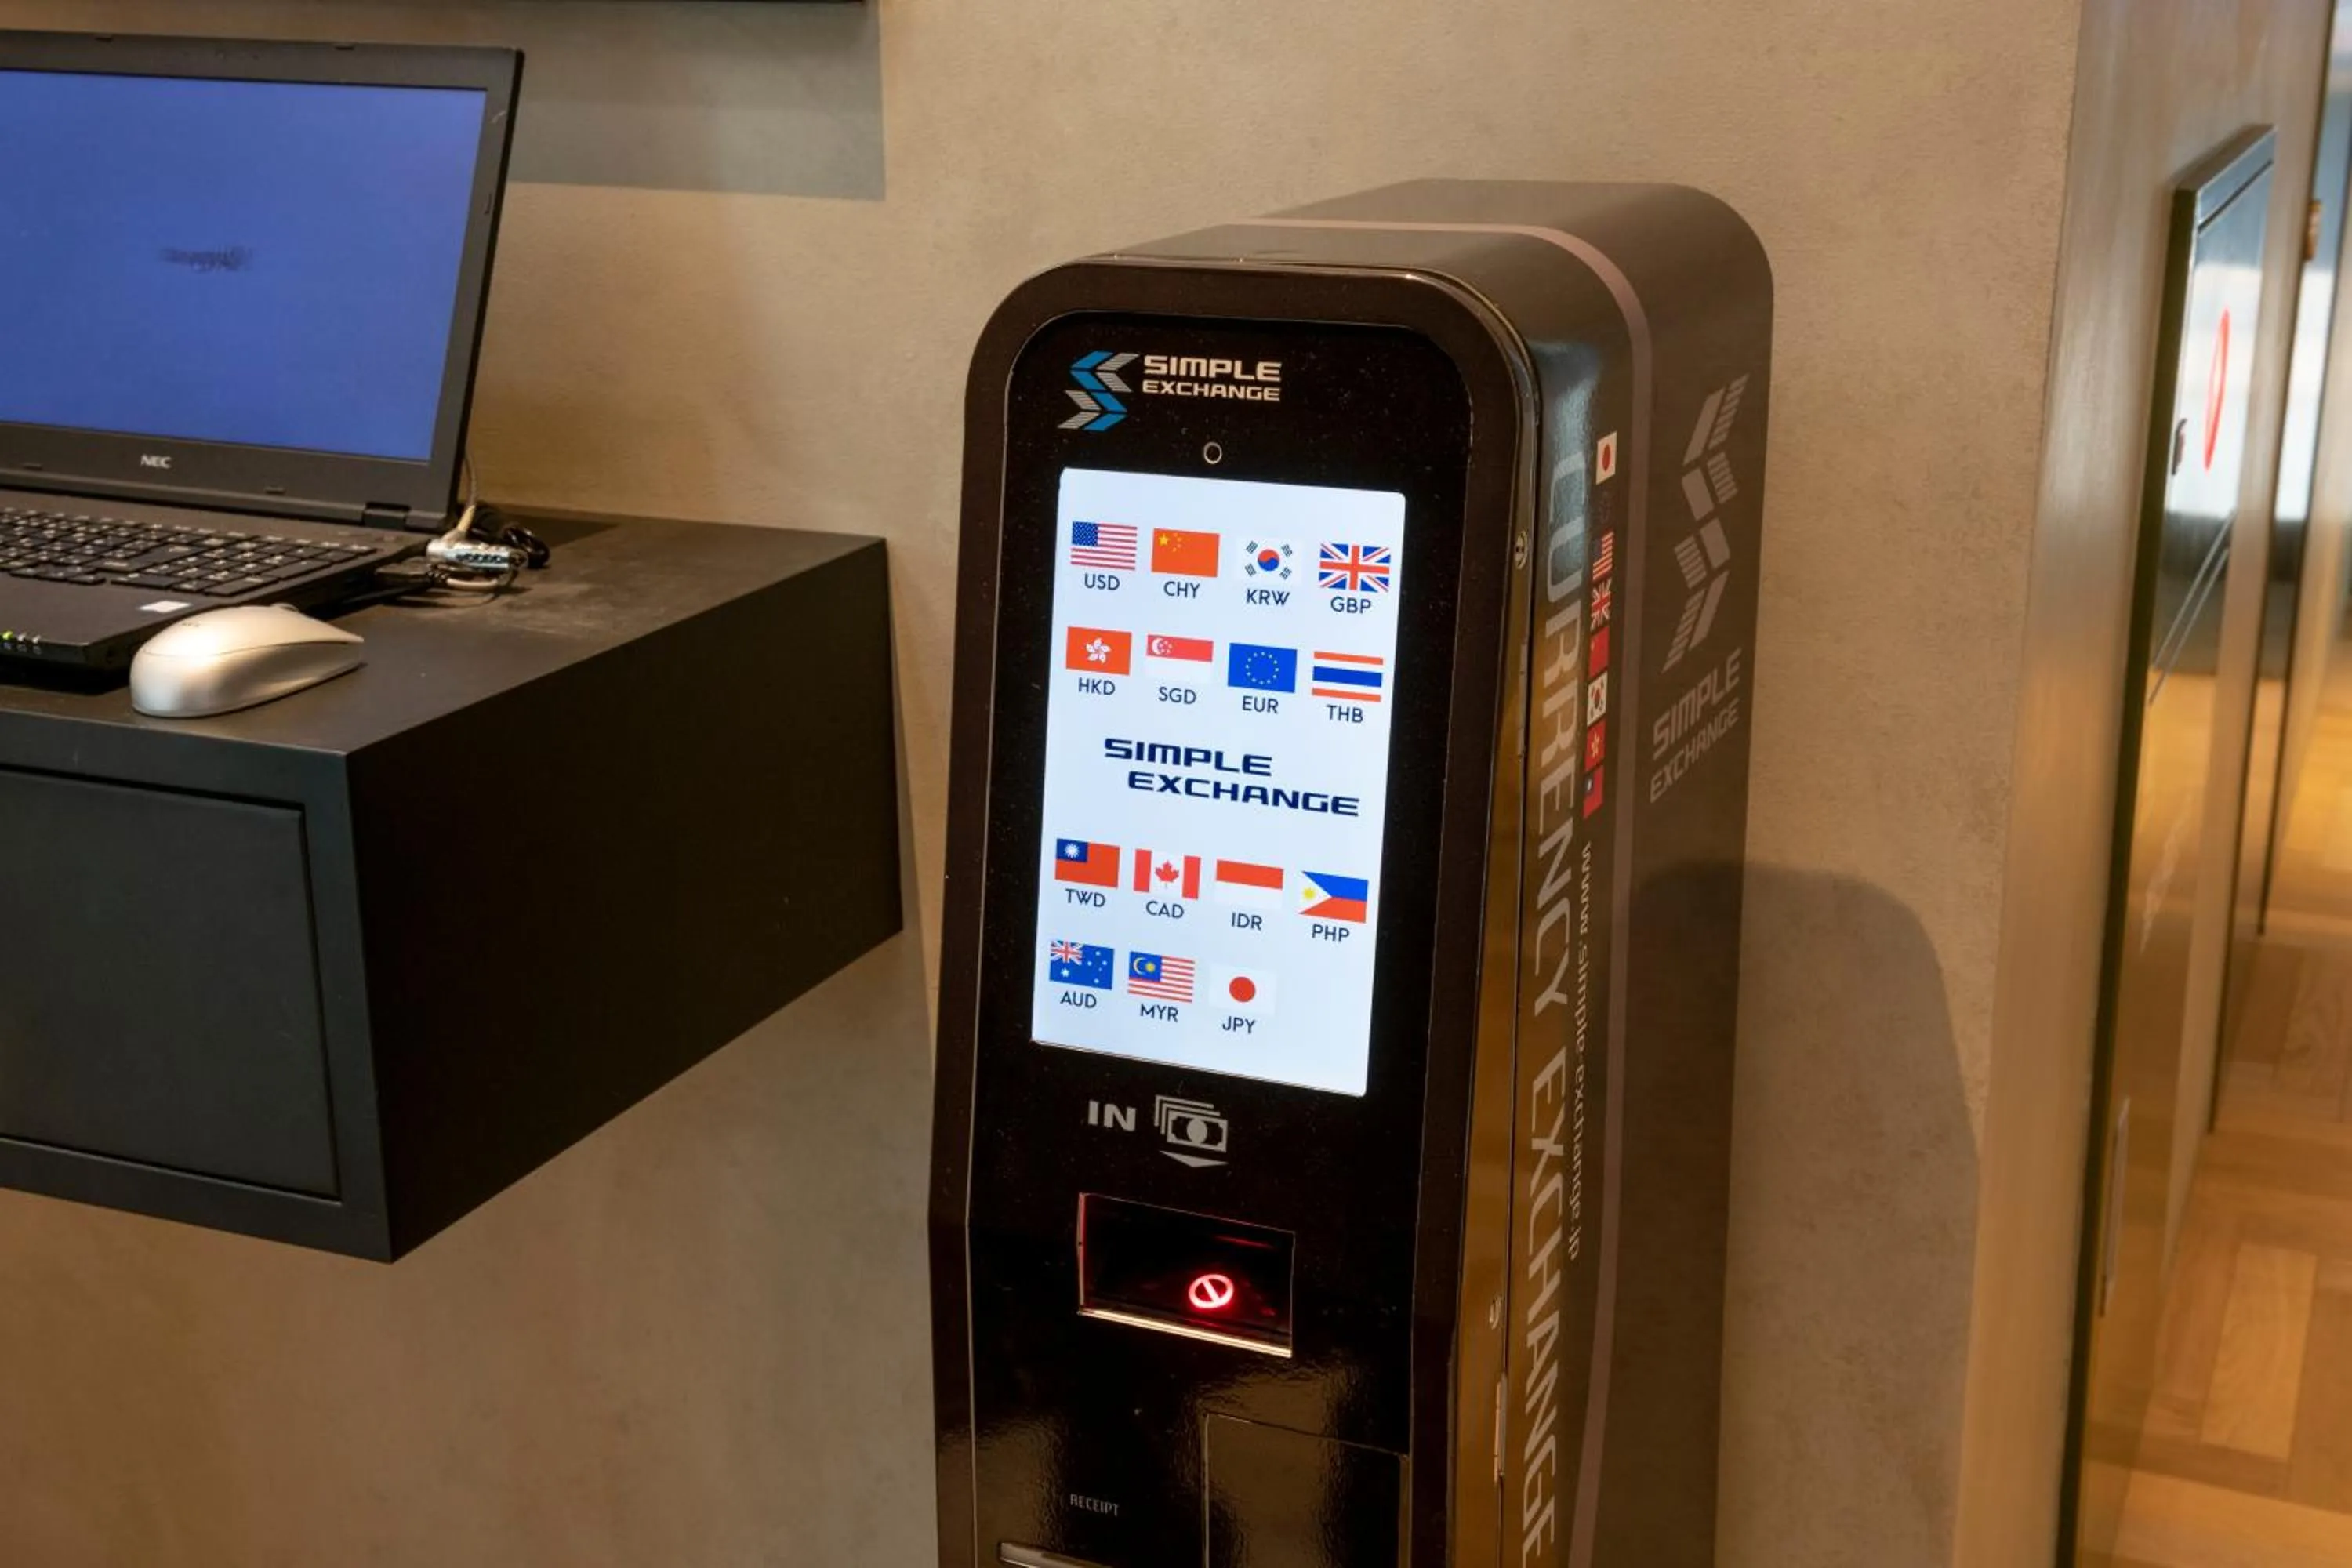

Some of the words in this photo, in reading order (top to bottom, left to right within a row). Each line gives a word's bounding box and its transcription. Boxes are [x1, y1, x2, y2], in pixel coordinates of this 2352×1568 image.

[1142, 354, 1283, 382] SIMPLE
[1142, 379, 1281, 402] EXCHANGE
[140, 453, 172, 469] NEC
[1083, 573, 1120, 591] USD
[1163, 581, 1201, 600] CHY
[1246, 589, 1290, 607] KRW
[1330, 597, 1372, 615] GBP
[1078, 678, 1116, 695] HKD
[1158, 686, 1197, 705] SGD
[1242, 695, 1279, 714] EUR
[1326, 704, 1364, 724] THB
[1653, 647, 1742, 761] SIMPLE
[1534, 450, 1586, 1017] CURRENCY
[1650, 696, 1740, 804] EXCHANGE
[1104, 738, 1272, 776] SIMPLE
[1128, 771, 1360, 816] EXCHANGE
[1065, 887, 1106, 908] TWD
[1145, 900, 1185, 919] CAD
[1231, 912, 1263, 931] IDR
[1311, 924, 1351, 943] PHP
[1059, 990, 1098, 1009] AUD
[1139, 1004, 1179, 1022] MYR
[1221, 1016, 1256, 1034] JPY
[1087, 1099, 1137, 1132] IN
[1522, 1044, 1567, 1568] EXCHANGE
[1070, 1493, 1120, 1517] RECEIPT
